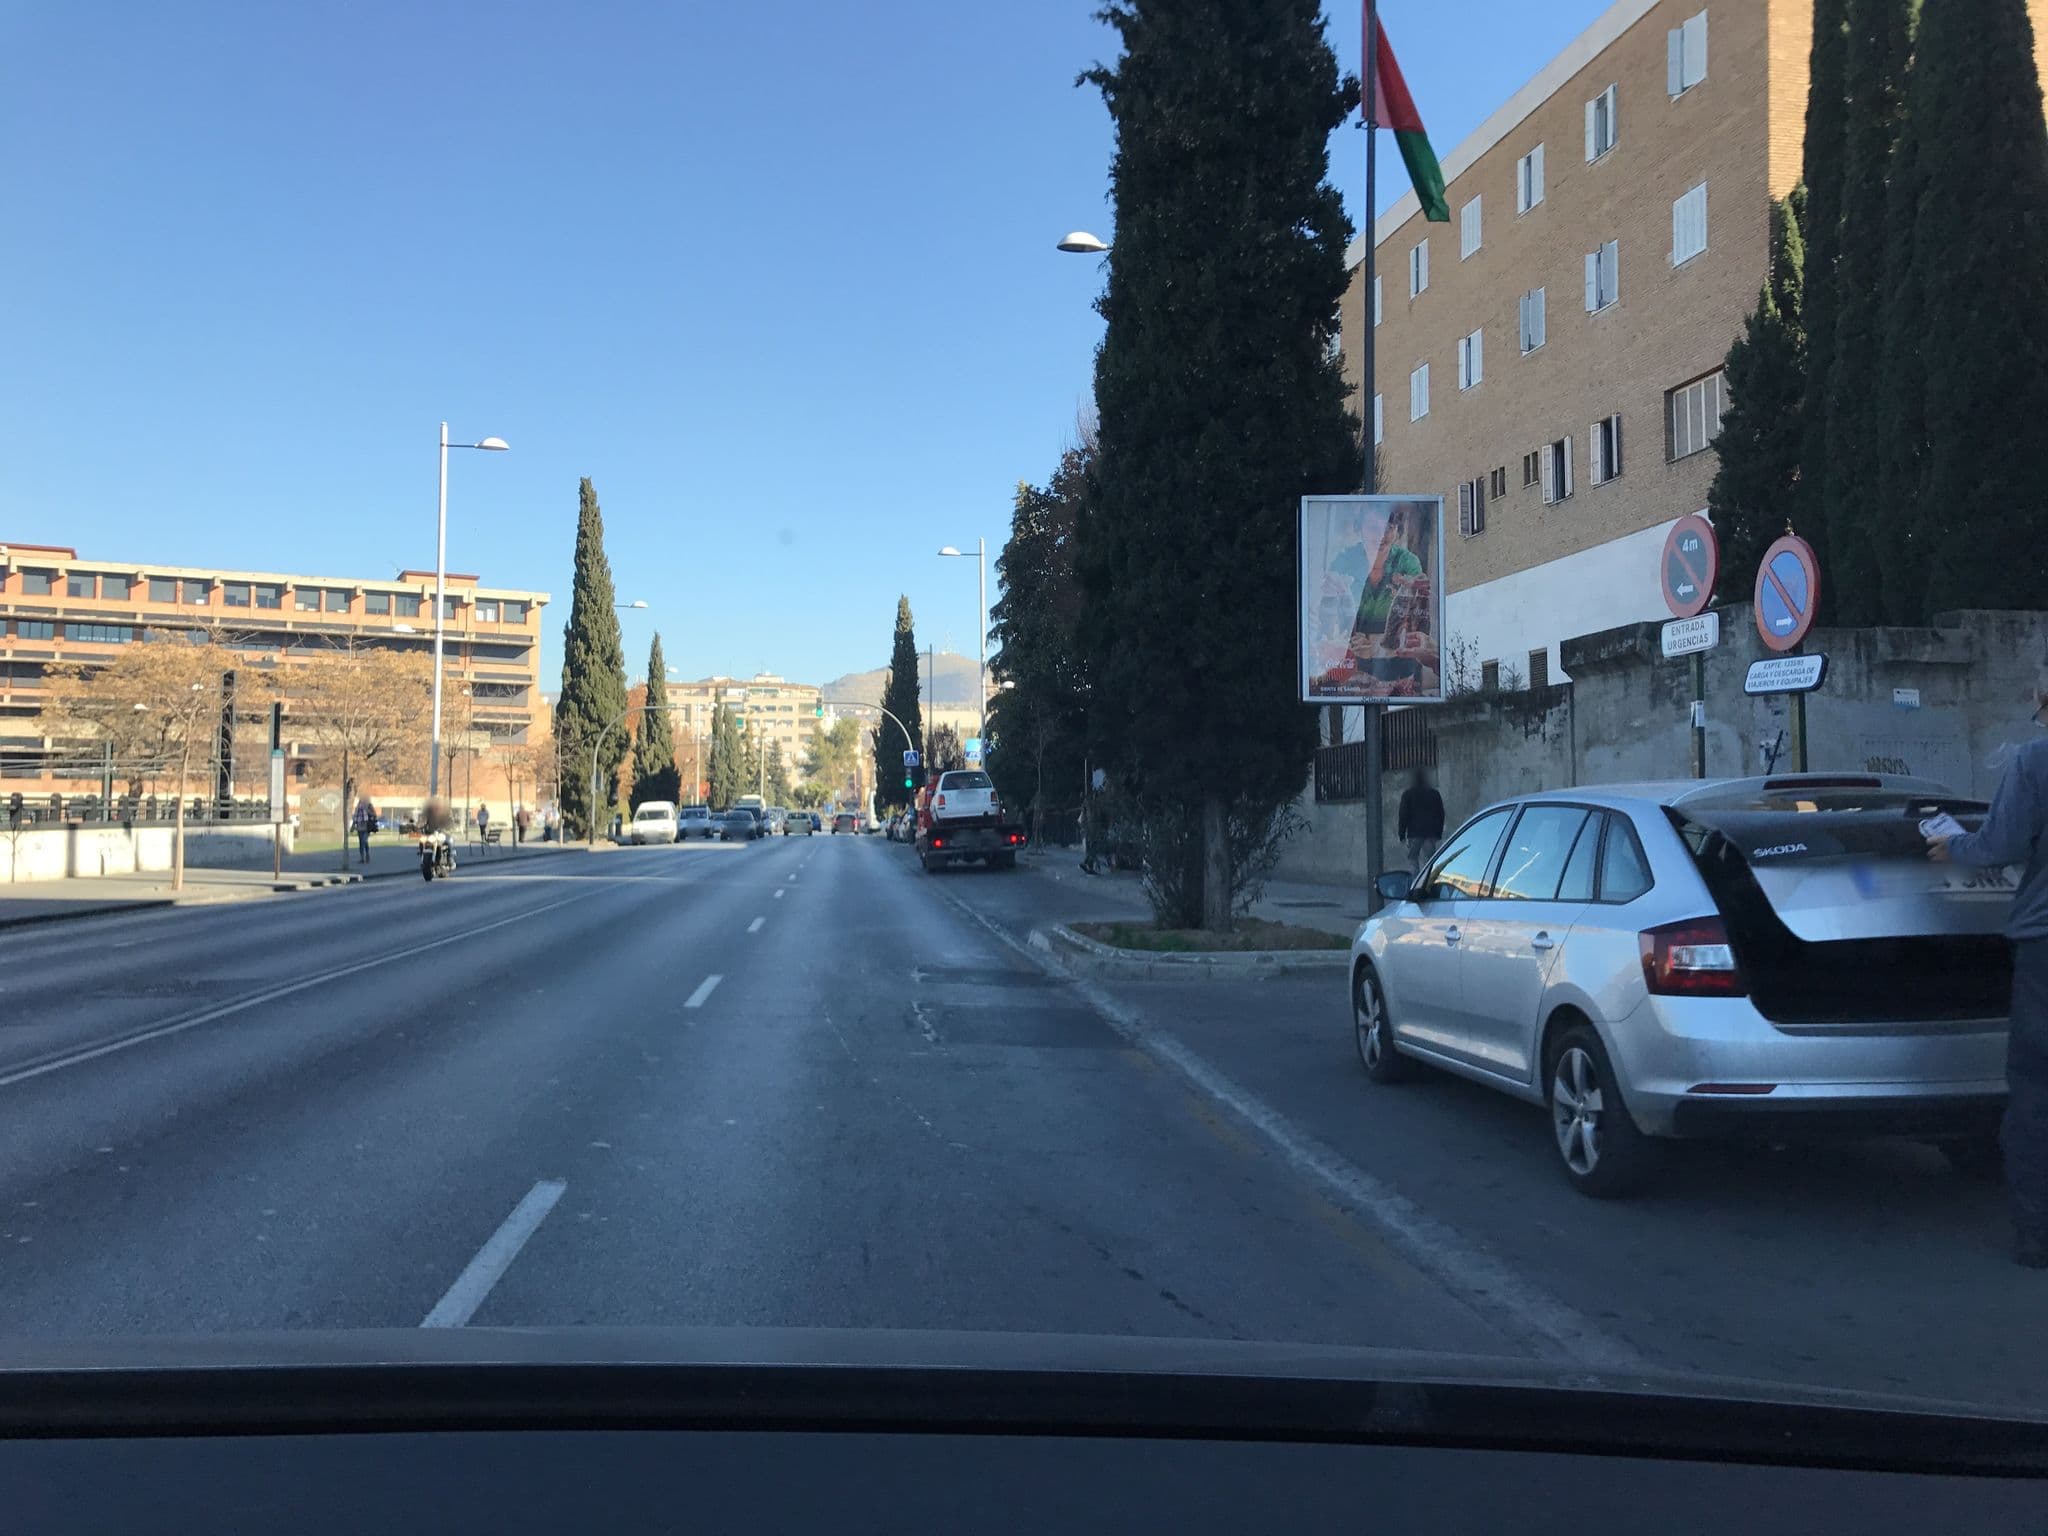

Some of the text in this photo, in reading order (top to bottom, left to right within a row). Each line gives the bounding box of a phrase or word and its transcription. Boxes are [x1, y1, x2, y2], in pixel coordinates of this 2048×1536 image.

[1682, 538, 1698, 552] 4m
[1671, 620, 1705, 636] ENTRADA
[1667, 633, 1709, 650] URGENCIAS
[1774, 667, 1805, 677] DESCARGA
